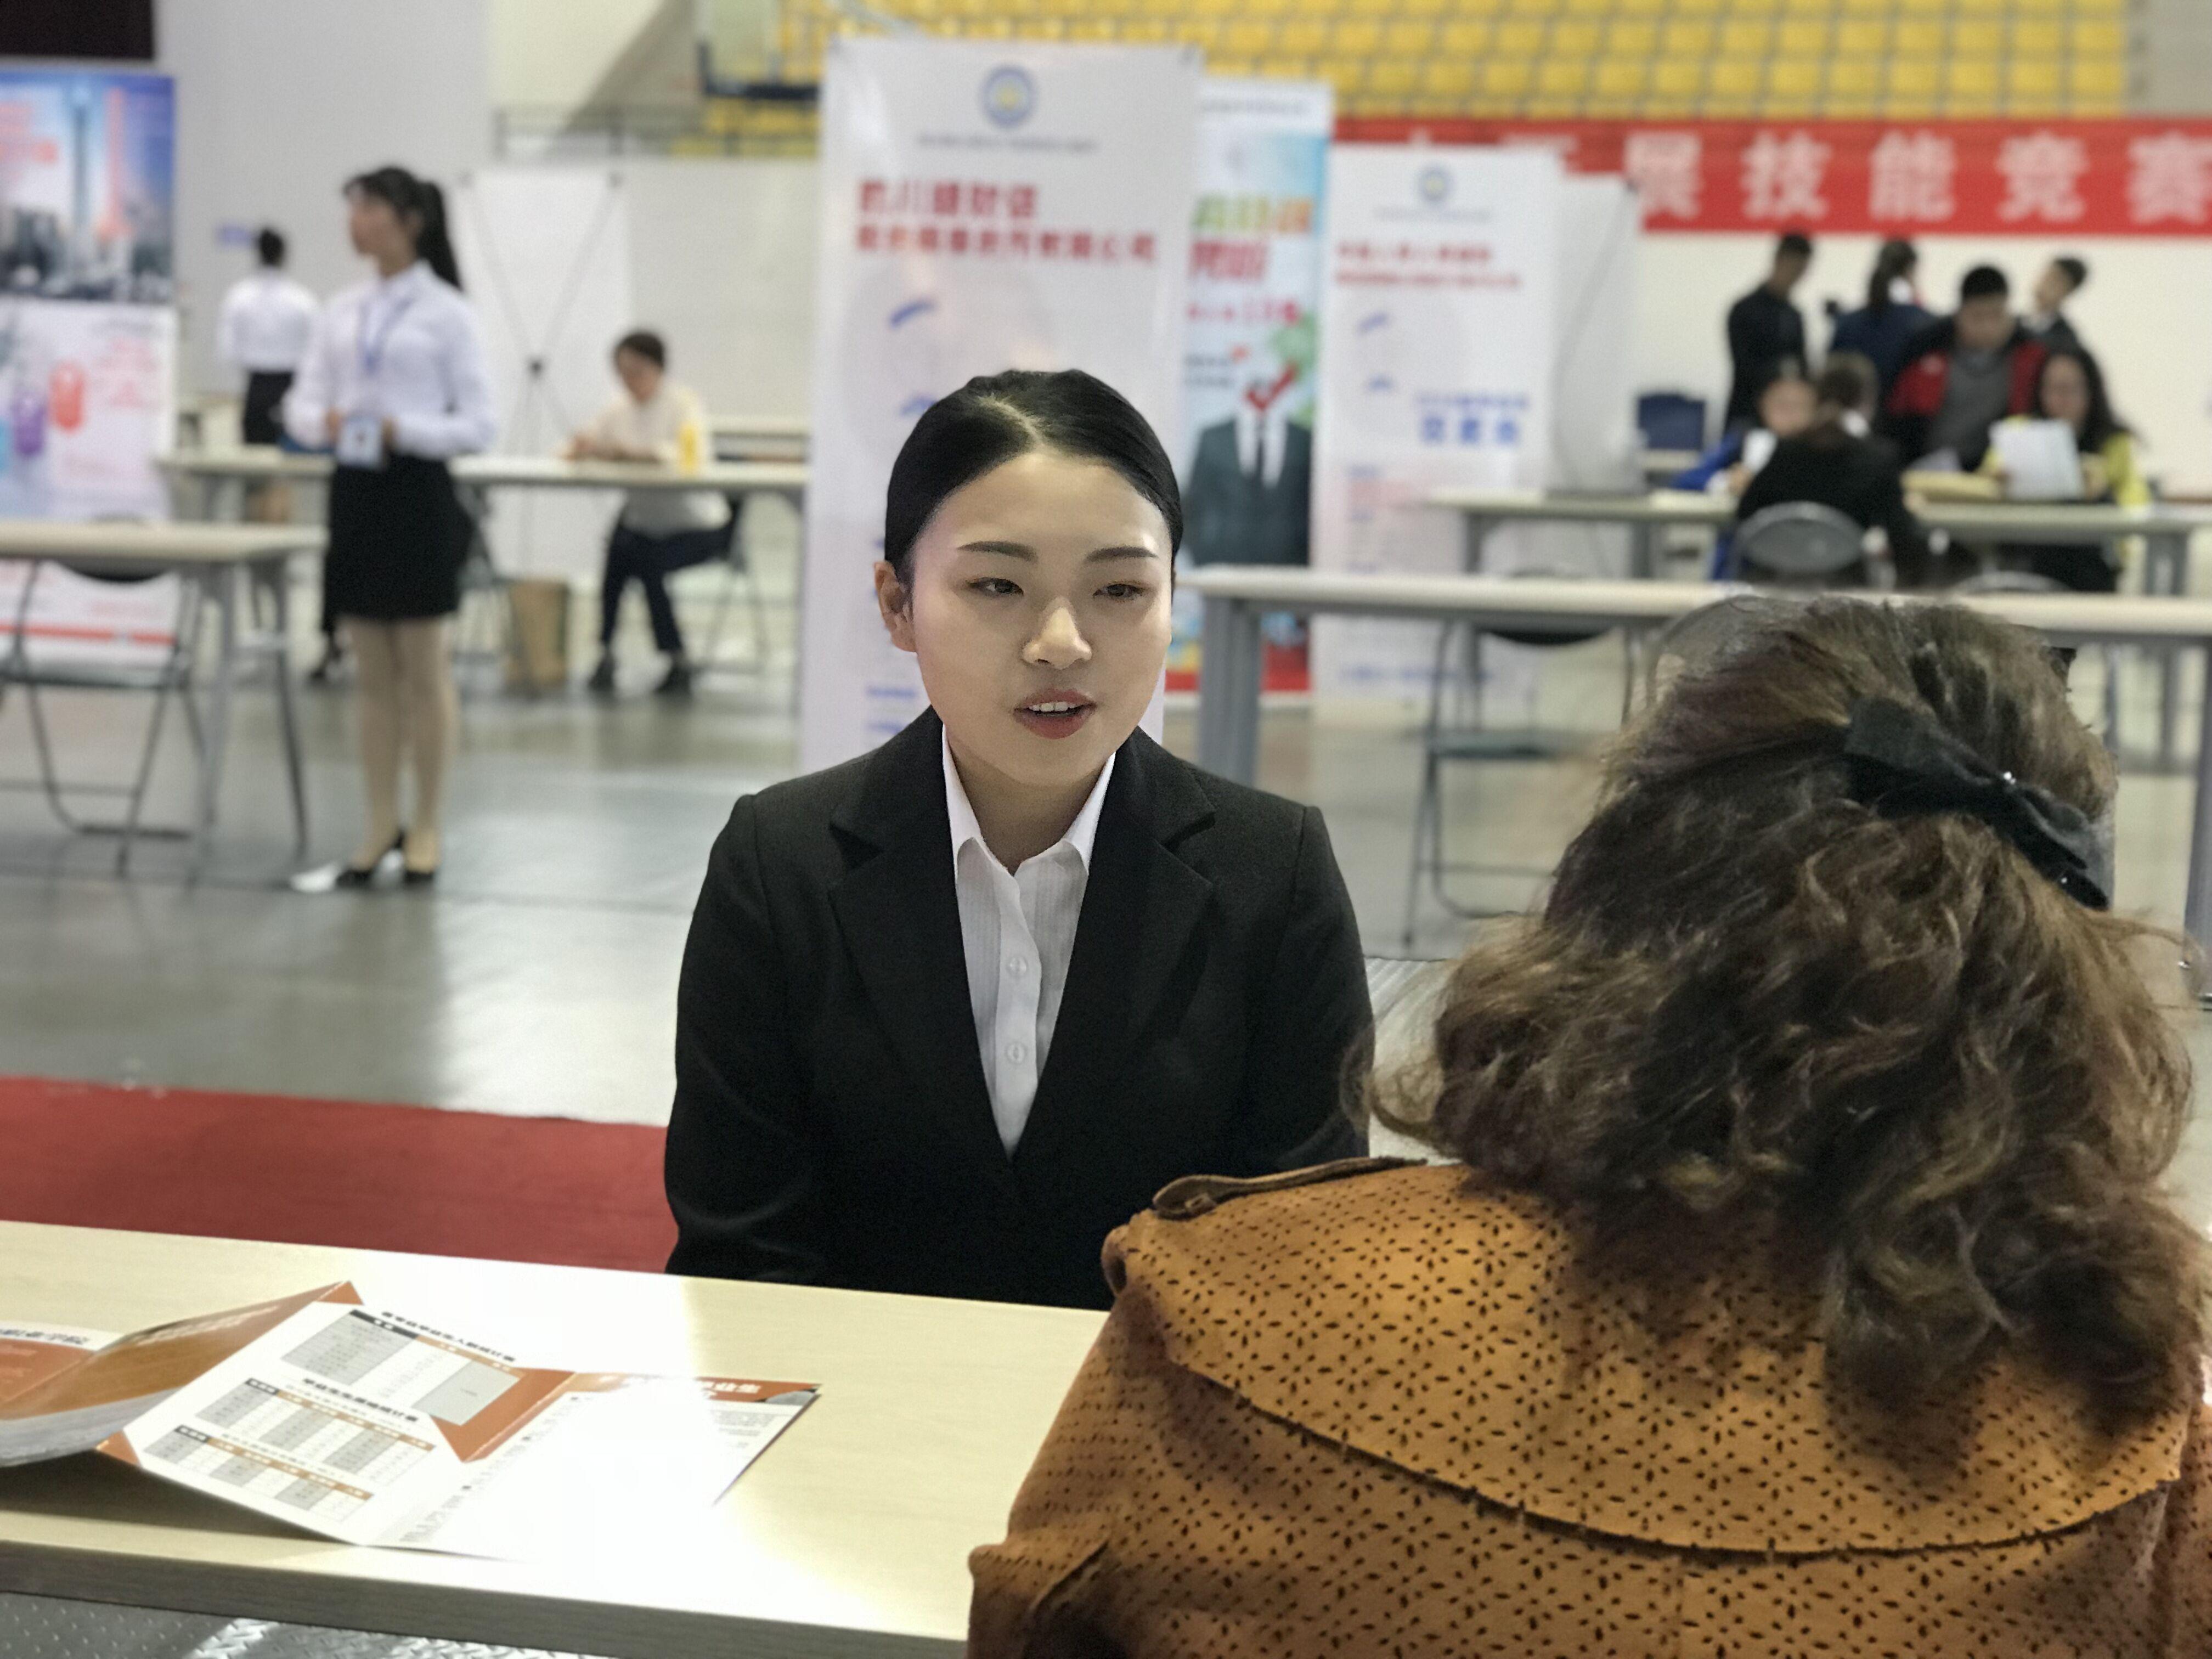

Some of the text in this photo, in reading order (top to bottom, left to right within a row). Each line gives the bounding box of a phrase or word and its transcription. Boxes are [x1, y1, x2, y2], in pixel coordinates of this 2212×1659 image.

[1408, 128, 2212, 222] 展技能竞赛
